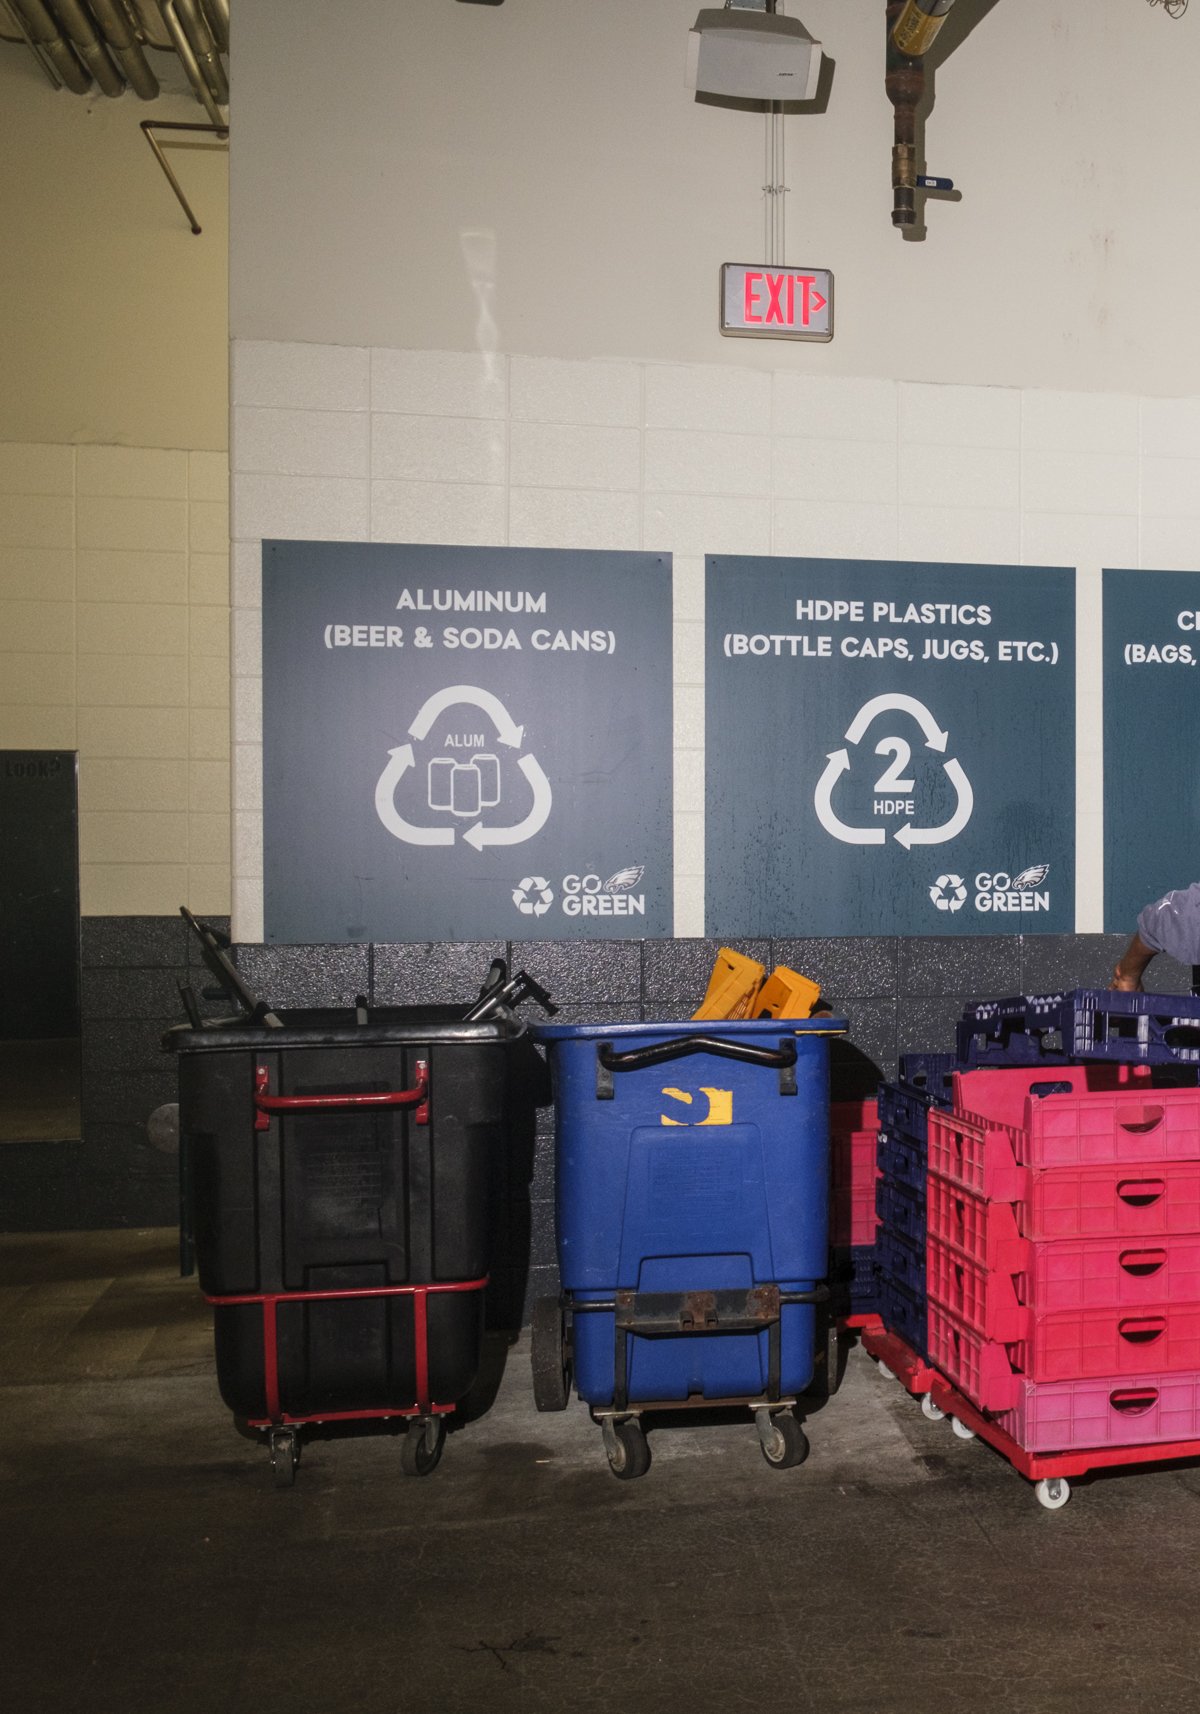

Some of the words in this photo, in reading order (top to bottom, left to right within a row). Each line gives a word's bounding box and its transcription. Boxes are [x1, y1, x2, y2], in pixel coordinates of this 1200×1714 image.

[744, 272, 816, 326] EXIT
[396, 588, 547, 613] ALUMINUM
[796, 599, 865, 622] HDPE
[873, 602, 992, 625] PLASTICS
[324, 625, 404, 649] (BEER
[413, 626, 434, 648] &
[443, 628, 522, 650] SODA
[531, 630, 616, 654] CANS)
[723, 633, 832, 657] (BOTTLE
[841, 637, 913, 661] CAPS,
[922, 639, 990, 664] JUGS,
[999, 641, 1059, 665] ETC.)
[1124, 644, 1197, 666] (BAGS,
[445, 733, 485, 748] ALUM
[874, 736, 916, 793] 2
[873, 799, 915, 815] HDPE
[562, 874, 602, 893] GO
[974, 872, 1011, 891] GO
[562, 894, 645, 916] GREEN
[974, 891, 1050, 912] GREEN
